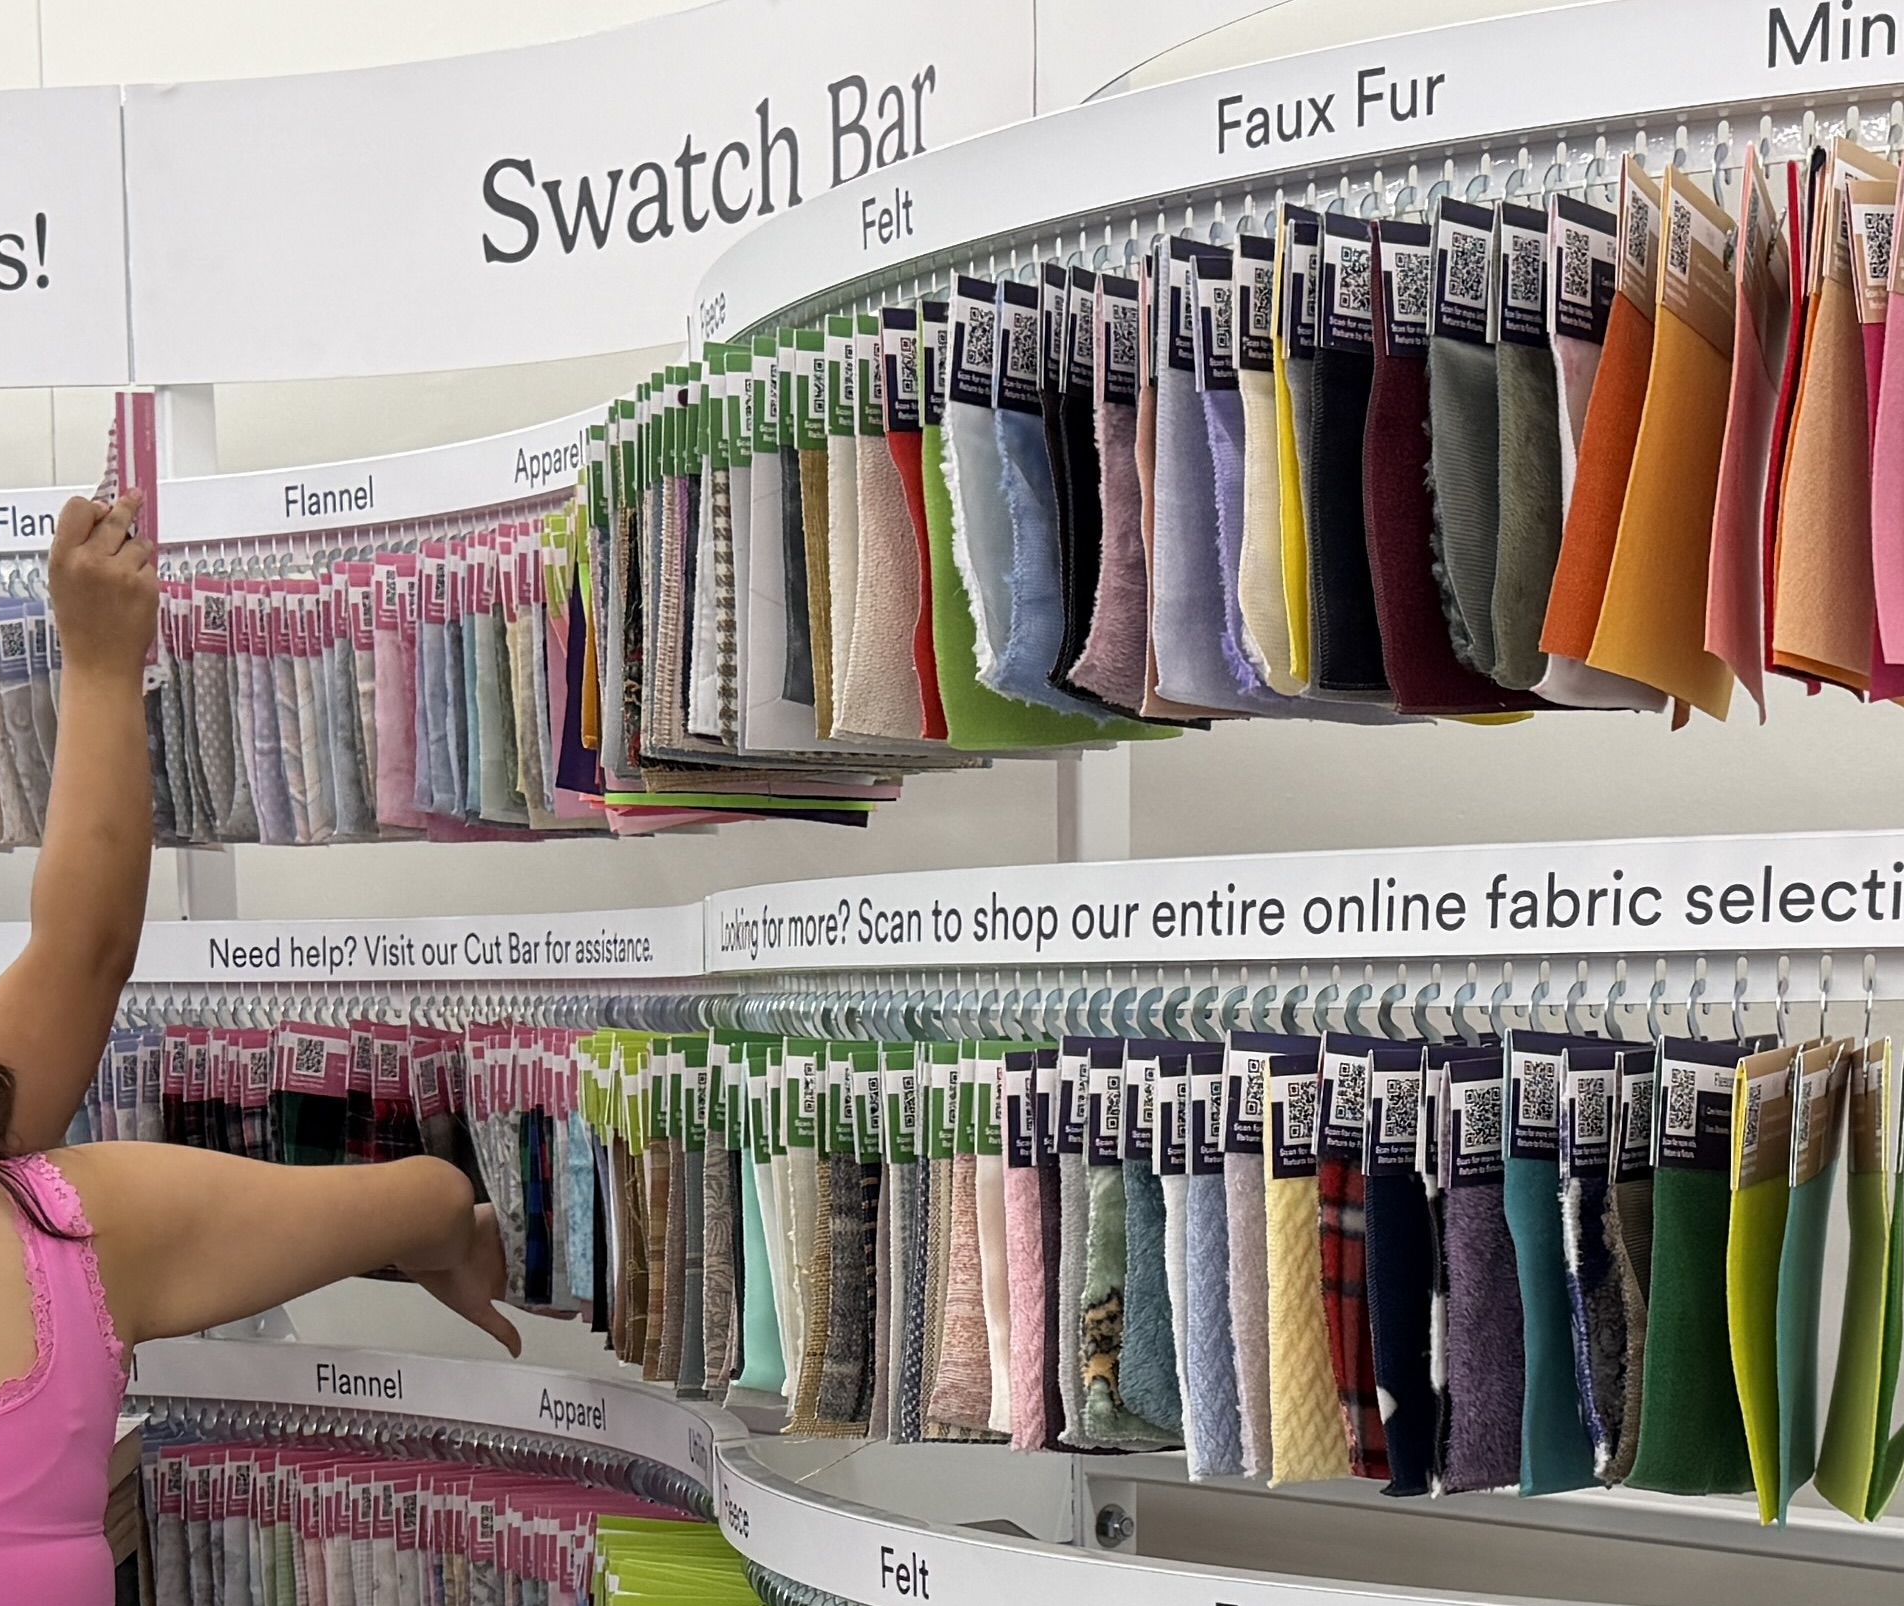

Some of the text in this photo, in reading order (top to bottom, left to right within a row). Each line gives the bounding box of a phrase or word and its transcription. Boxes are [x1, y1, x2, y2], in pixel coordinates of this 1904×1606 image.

[1217, 69, 1446, 155] Faux Fur
[482, 64, 936, 264] Swatch Bar
[861, 187, 914, 251] Felt
[514, 429, 585, 488] Apparel
[284, 474, 374, 518] Flannel
[720, 907, 759, 961] Looking
[761, 904, 784, 949] for
[788, 898, 851, 947] more?
[857, 897, 922, 945] Scan
[931, 899, 962, 943] to
[972, 891, 1058, 953] shop
[1071, 902, 1140, 941] our
[1152, 882, 1285, 939] entire
[1303, 876, 1466, 935] online
[1485, 869, 1663, 930] fabric
[209, 928, 654, 976] Need help? Visit our Cut Bar for assistance.
[316, 1363, 403, 1400] Flannel
[535, 1387, 607, 1436] Apparel
[880, 1545, 930, 1601] Felt
